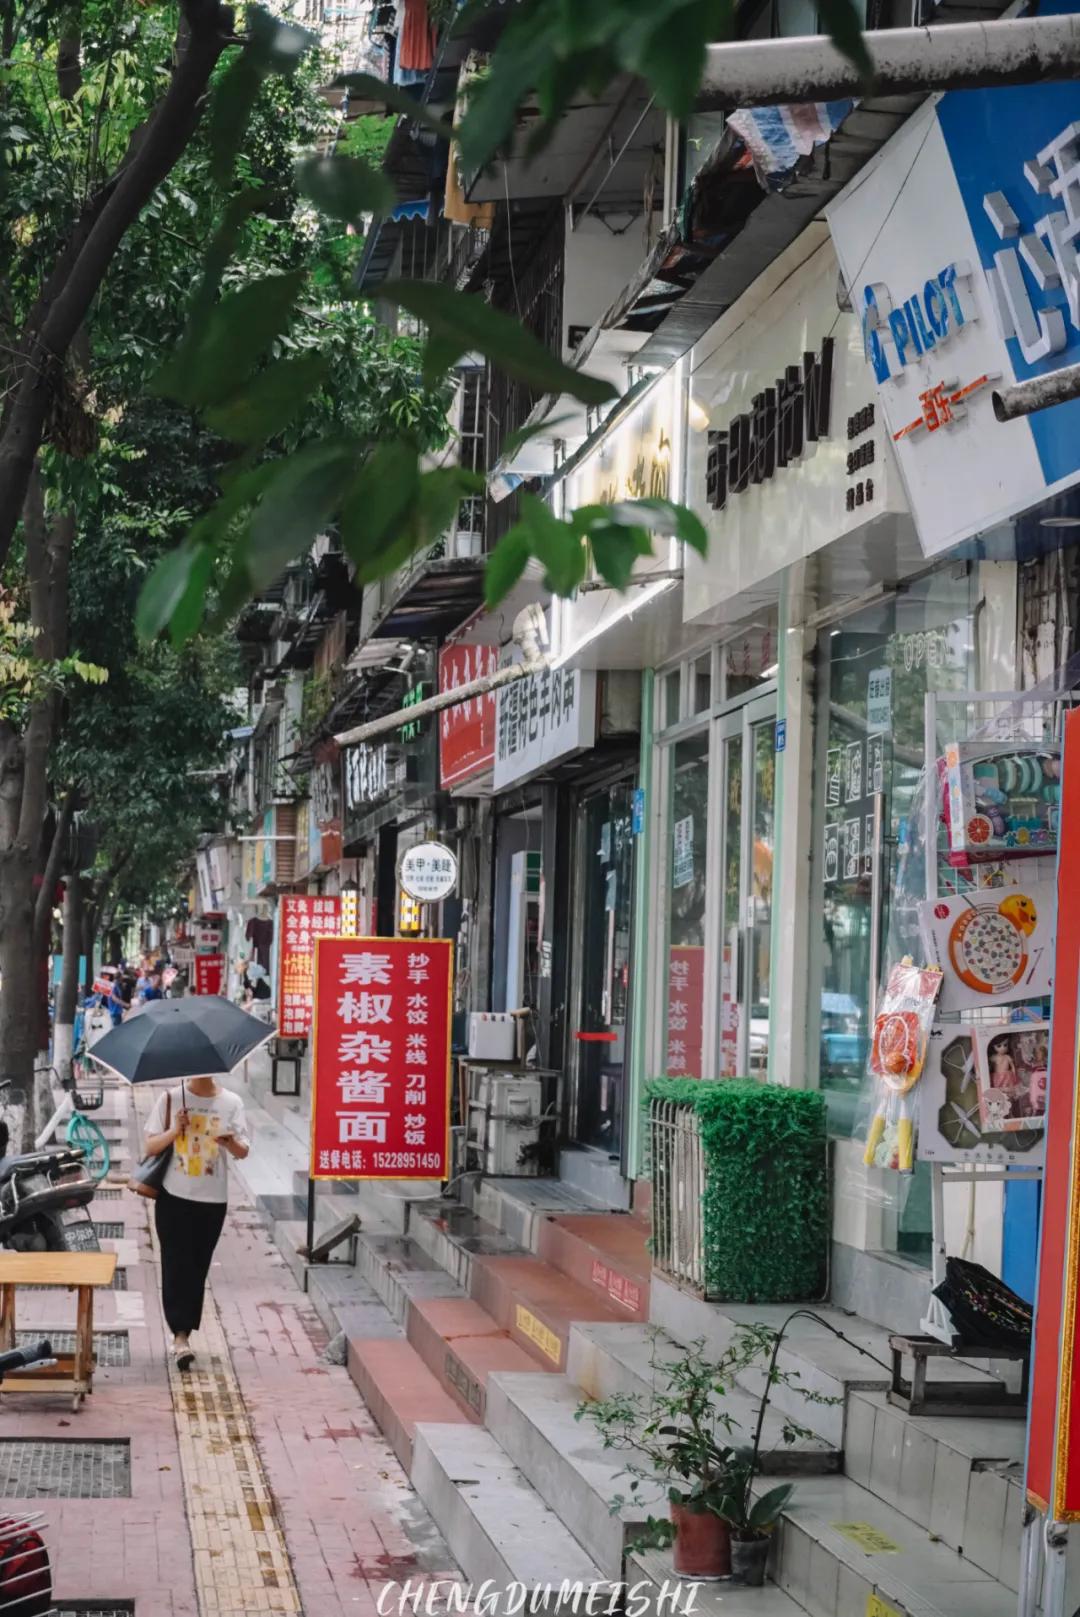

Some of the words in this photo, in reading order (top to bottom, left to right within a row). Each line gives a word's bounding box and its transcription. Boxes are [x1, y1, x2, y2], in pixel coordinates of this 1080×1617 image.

[888, 262, 966, 367] PILOT
[407, 953, 430, 984] 抄手
[406, 993, 428, 1025] 水饺
[336, 952, 394, 1144] 素椒杂酱面
[405, 1033, 428, 1065] 米线
[404, 1074, 426, 1105] 刀削
[404, 1113, 427, 1145] 炒饭
[372, 1151, 441, 1169] 15228951450
